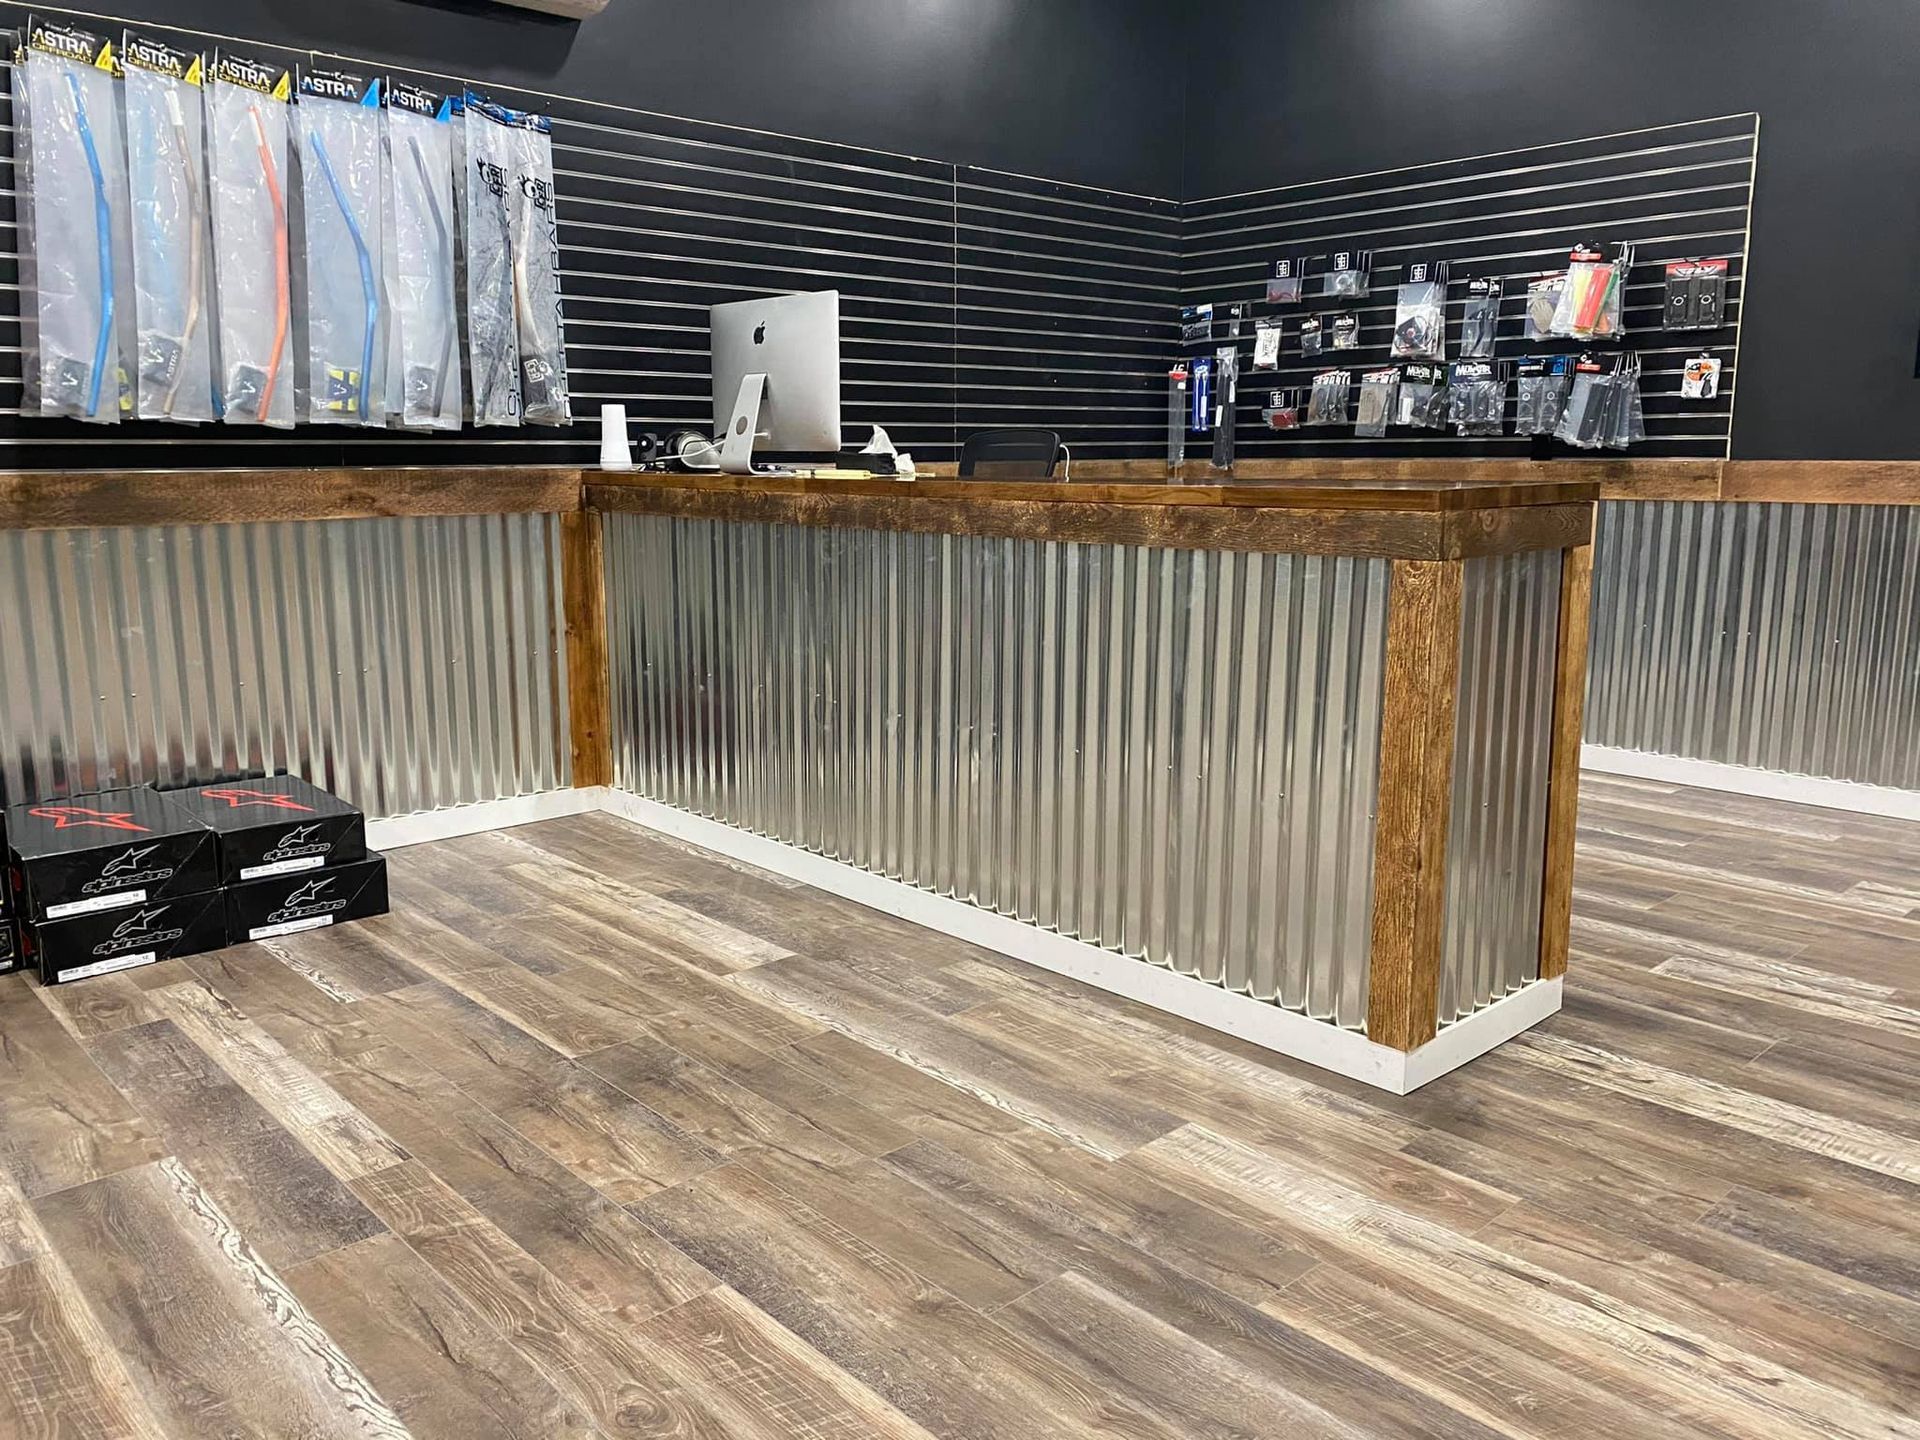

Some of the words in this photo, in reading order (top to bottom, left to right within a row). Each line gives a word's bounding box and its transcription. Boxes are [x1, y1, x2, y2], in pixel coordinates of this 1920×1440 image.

[32, 27, 92, 57] ASTRA
[127, 42, 182, 72] ASTRA
[219, 60, 271, 88] ASTRA
[301, 76, 357, 98] ASTRA
[391, 89, 434, 113] ASTRA
